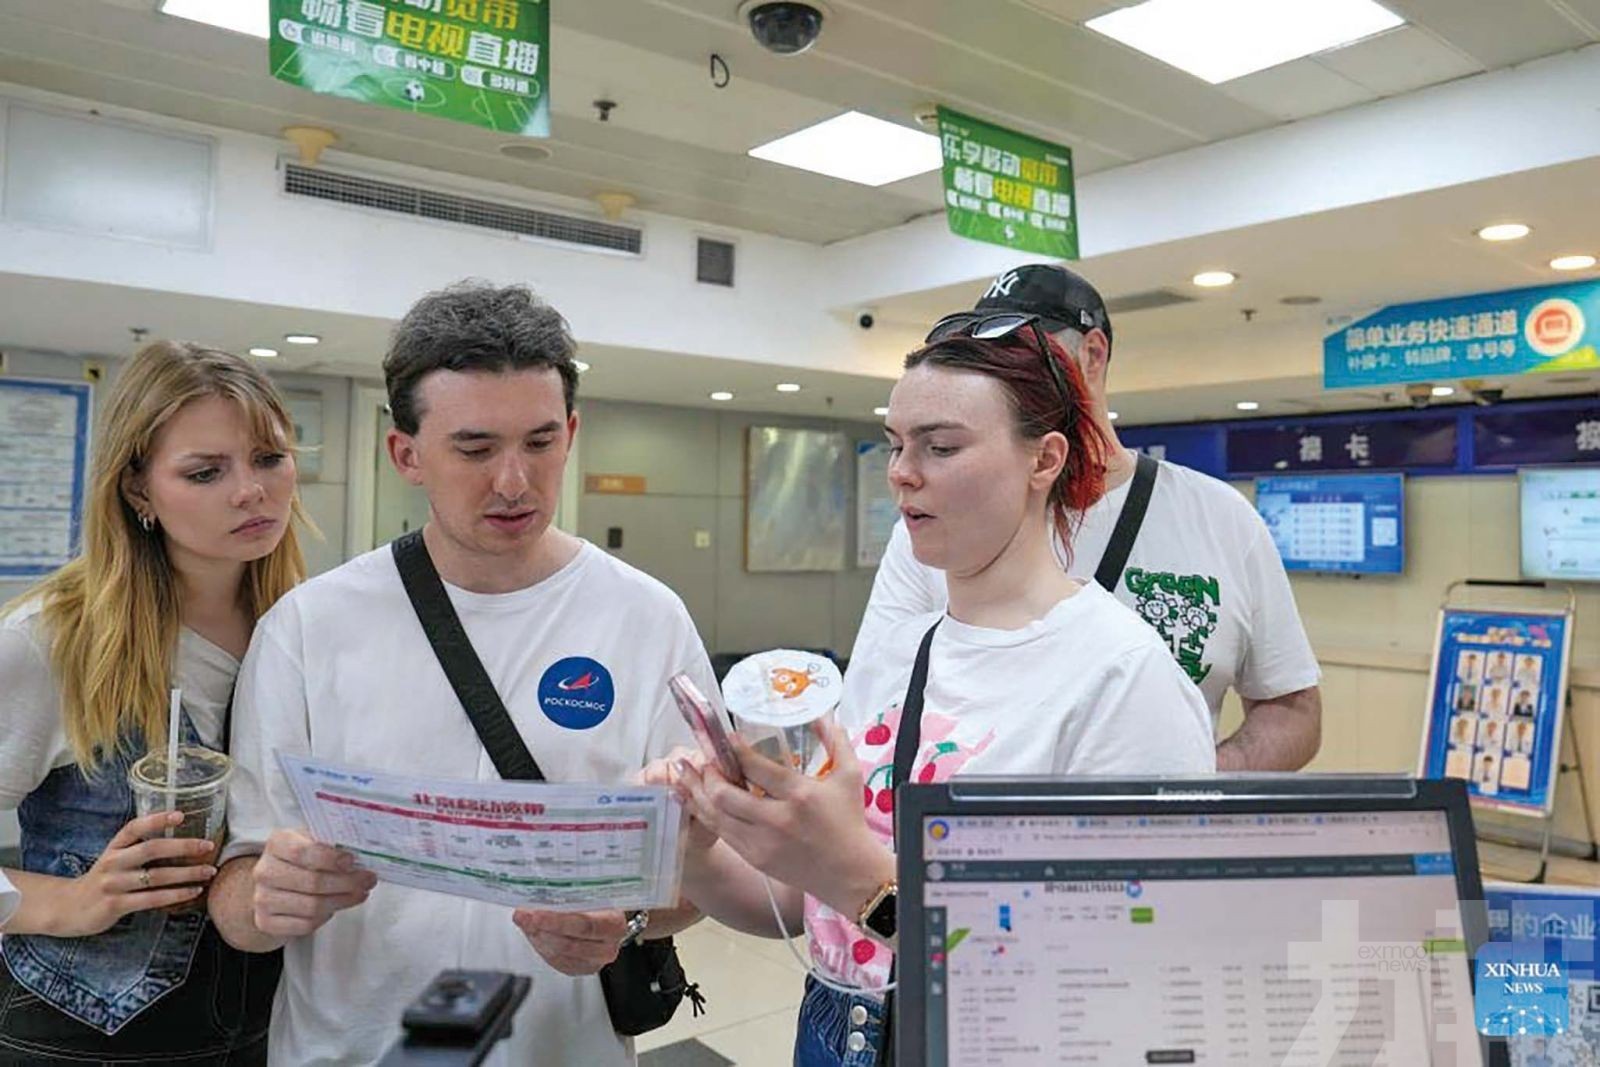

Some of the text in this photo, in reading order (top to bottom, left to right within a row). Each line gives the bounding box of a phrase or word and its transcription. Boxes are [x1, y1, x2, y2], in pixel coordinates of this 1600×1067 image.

[301, 0, 540, 75] 畅看电视直播
[983, 271, 1020, 298] NY
[544, 697, 606, 712] РОСКОСМОС
